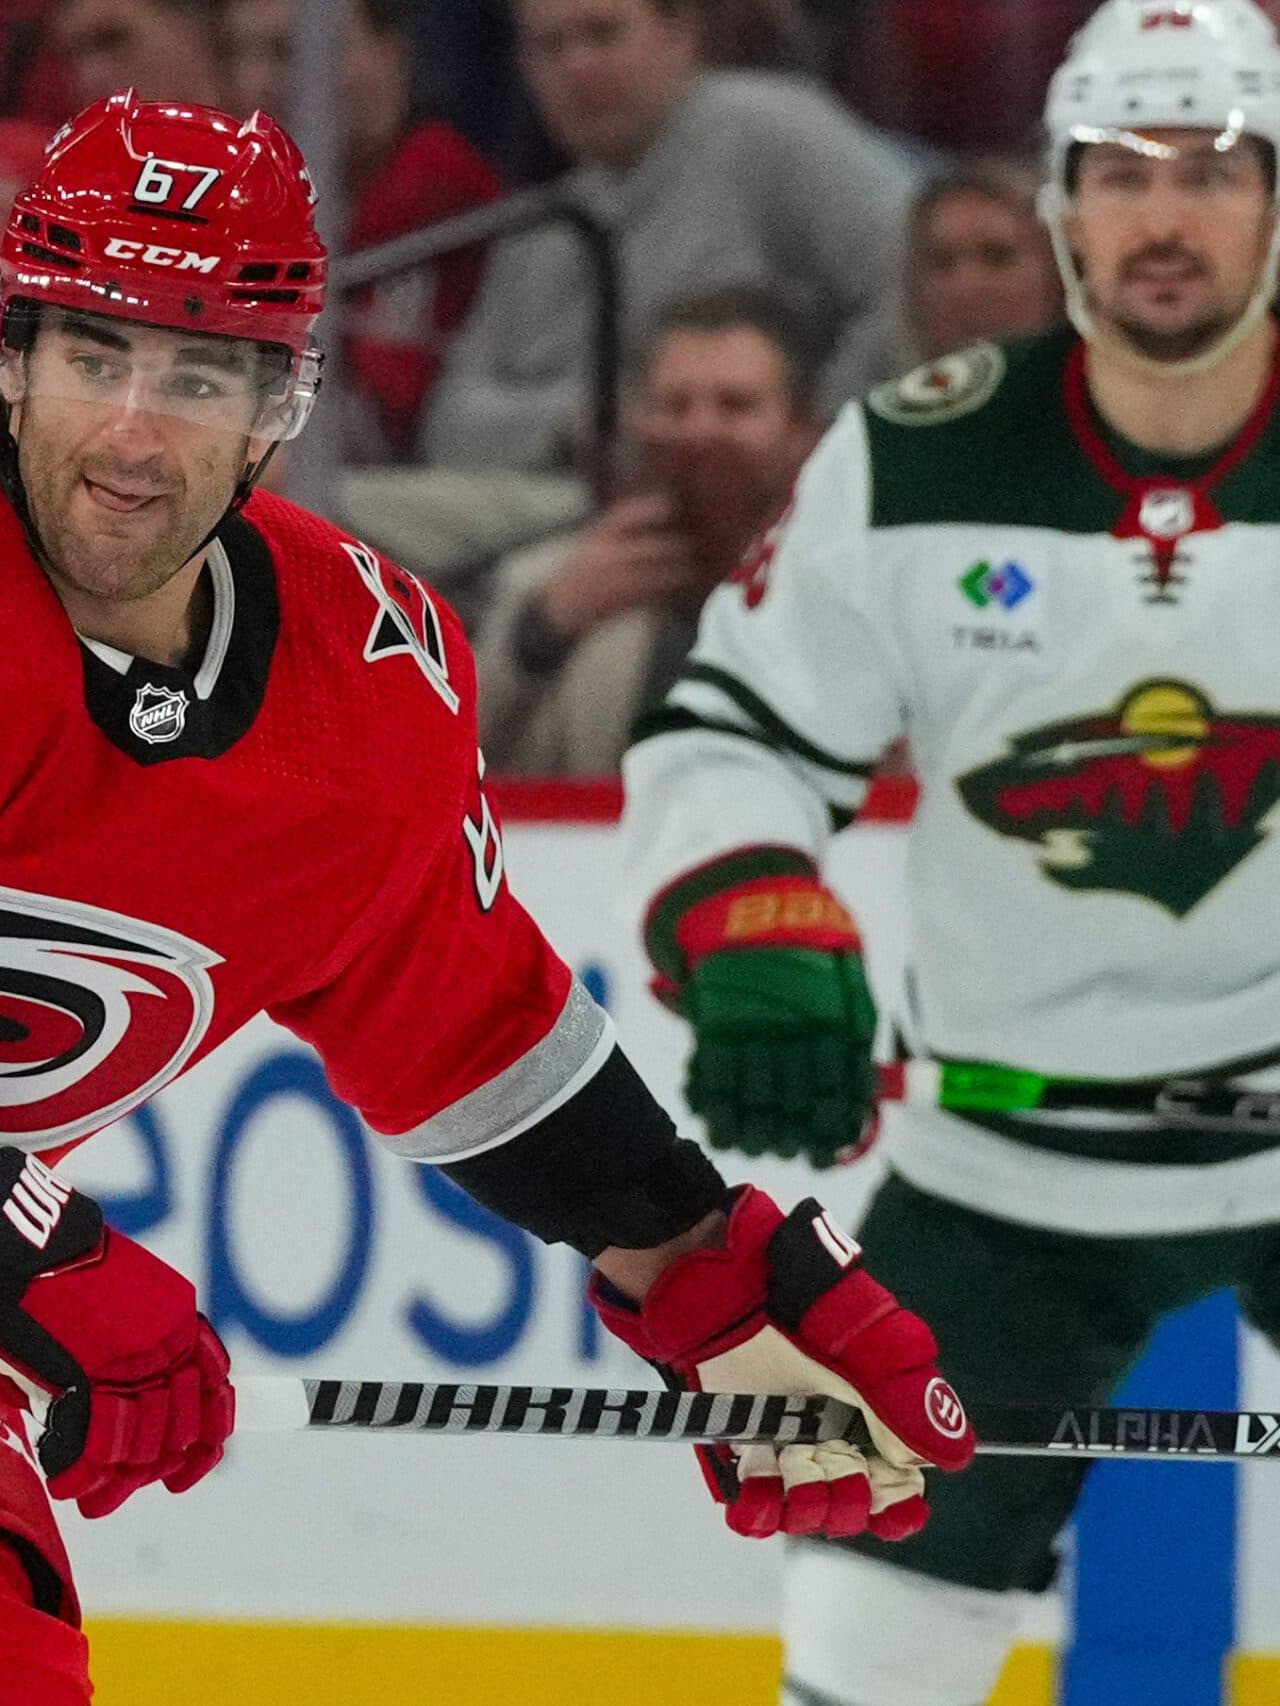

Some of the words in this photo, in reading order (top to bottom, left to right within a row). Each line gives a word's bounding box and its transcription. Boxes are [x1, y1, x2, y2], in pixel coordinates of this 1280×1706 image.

[133, 158, 220, 210] 67
[103, 237, 221, 273] CCM
[141, 704, 175, 728] NHL
[308, 1379, 824, 1442] WARRIOR
[1047, 1410, 1219, 1453] ALPHA
